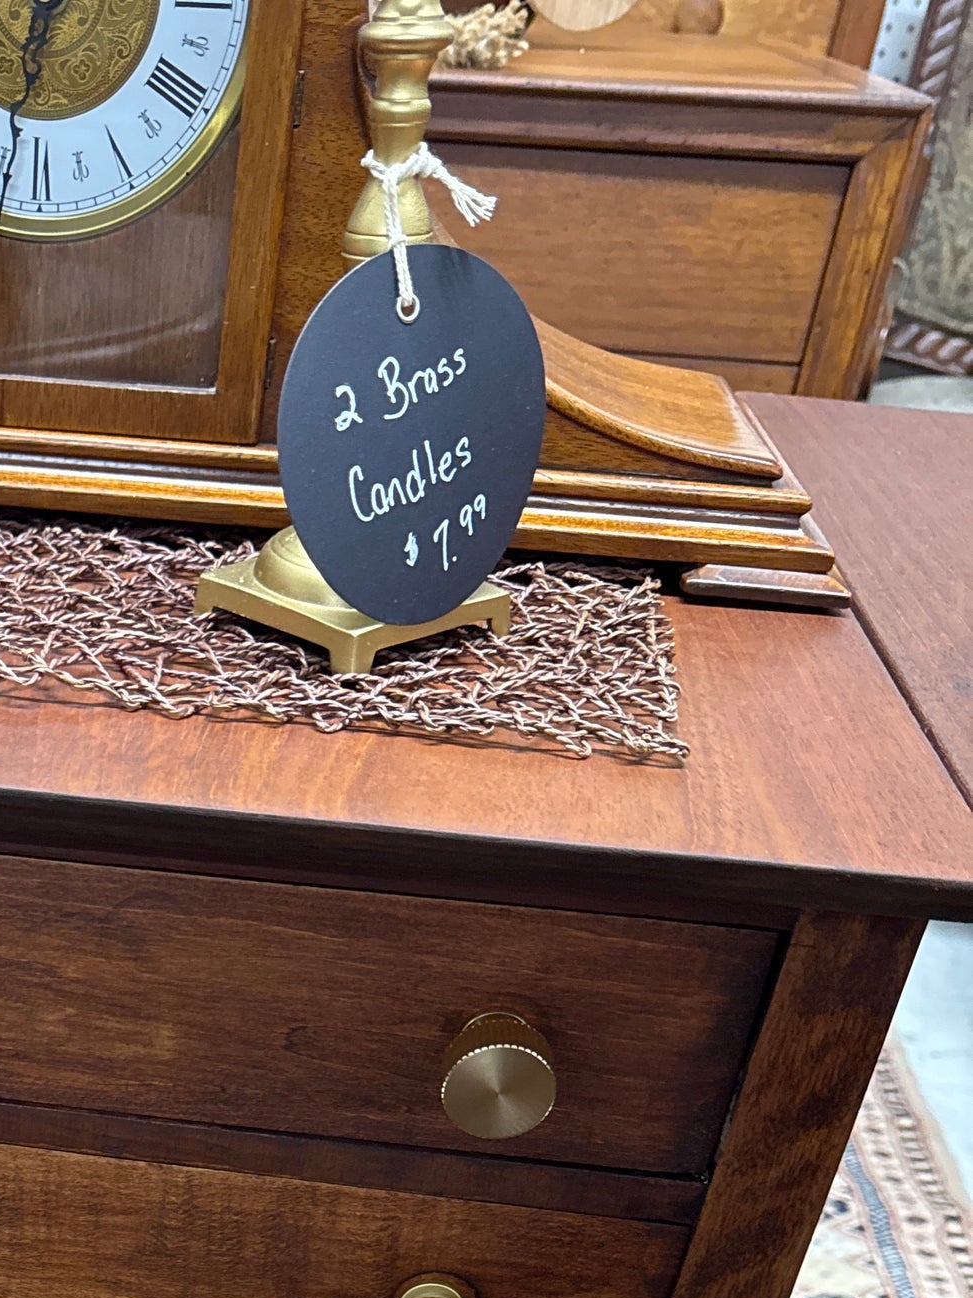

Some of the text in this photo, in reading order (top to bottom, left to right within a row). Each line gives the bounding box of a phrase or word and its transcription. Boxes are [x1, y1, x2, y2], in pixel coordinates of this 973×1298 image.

[334, 347, 467, 432] 2 Brass
[348, 436, 473, 522] Candles
